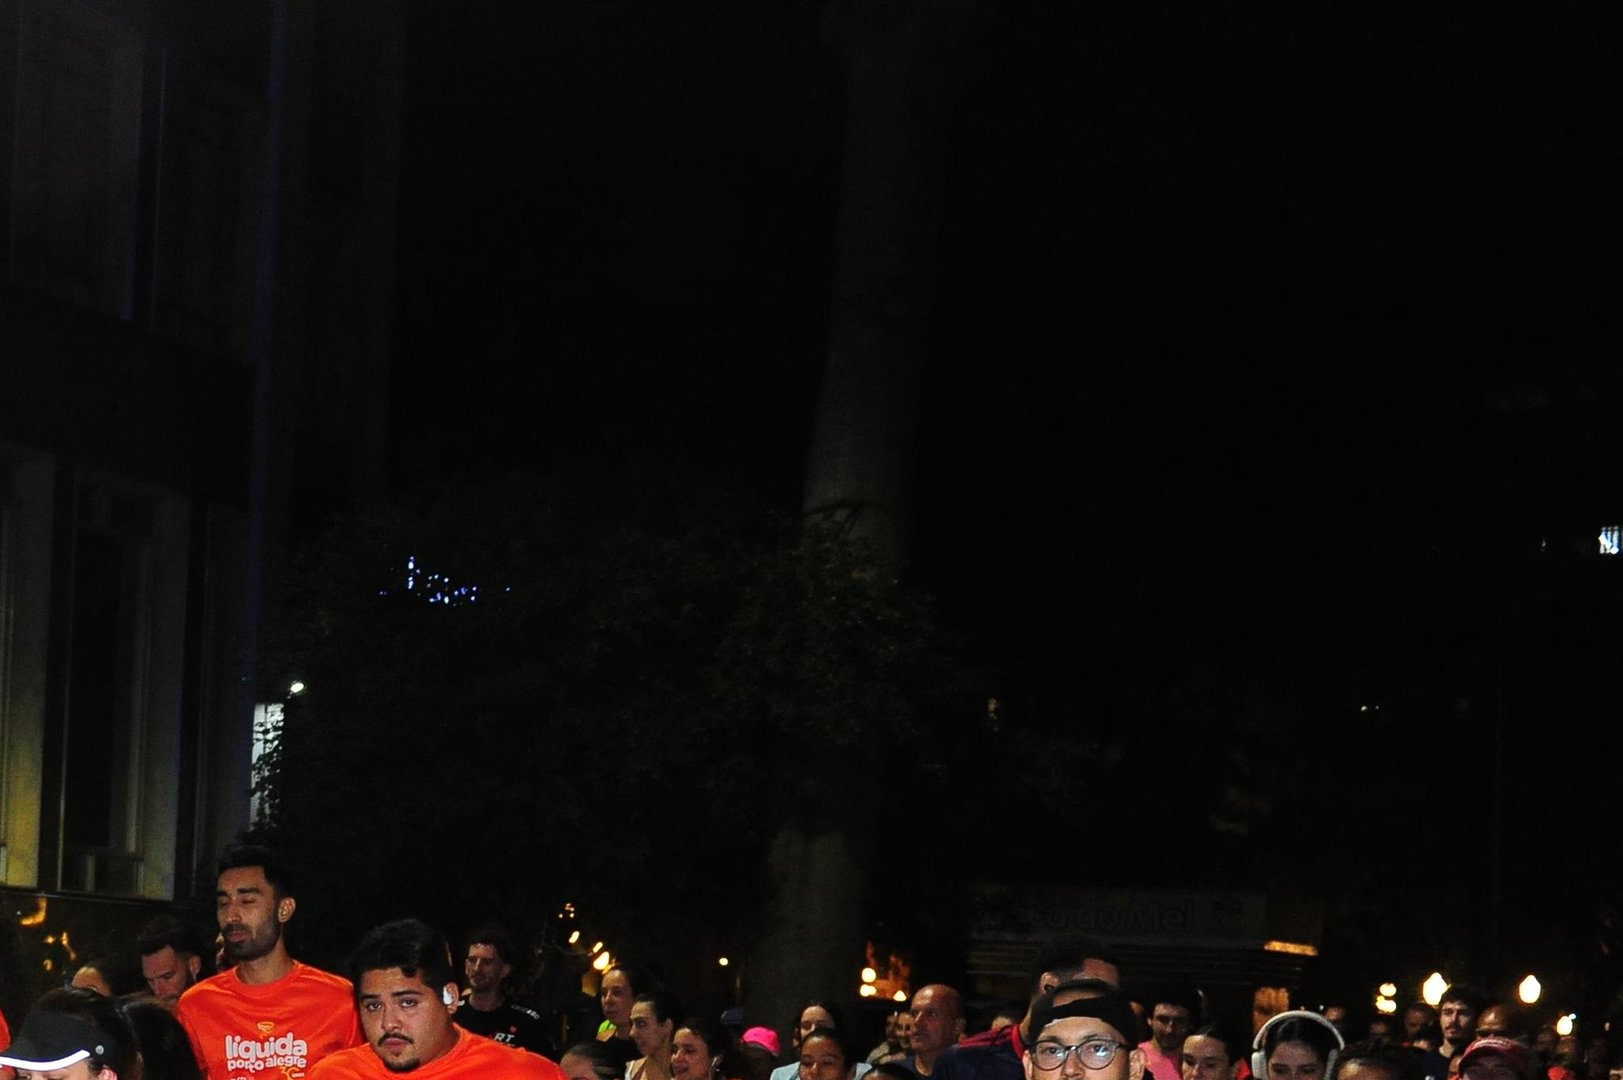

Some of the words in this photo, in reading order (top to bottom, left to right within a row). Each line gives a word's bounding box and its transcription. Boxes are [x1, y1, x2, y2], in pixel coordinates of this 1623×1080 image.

[225, 1032, 308, 1065] liquida
[227, 1059, 265, 1073] porto
[265, 1054, 308, 1068] alegre
